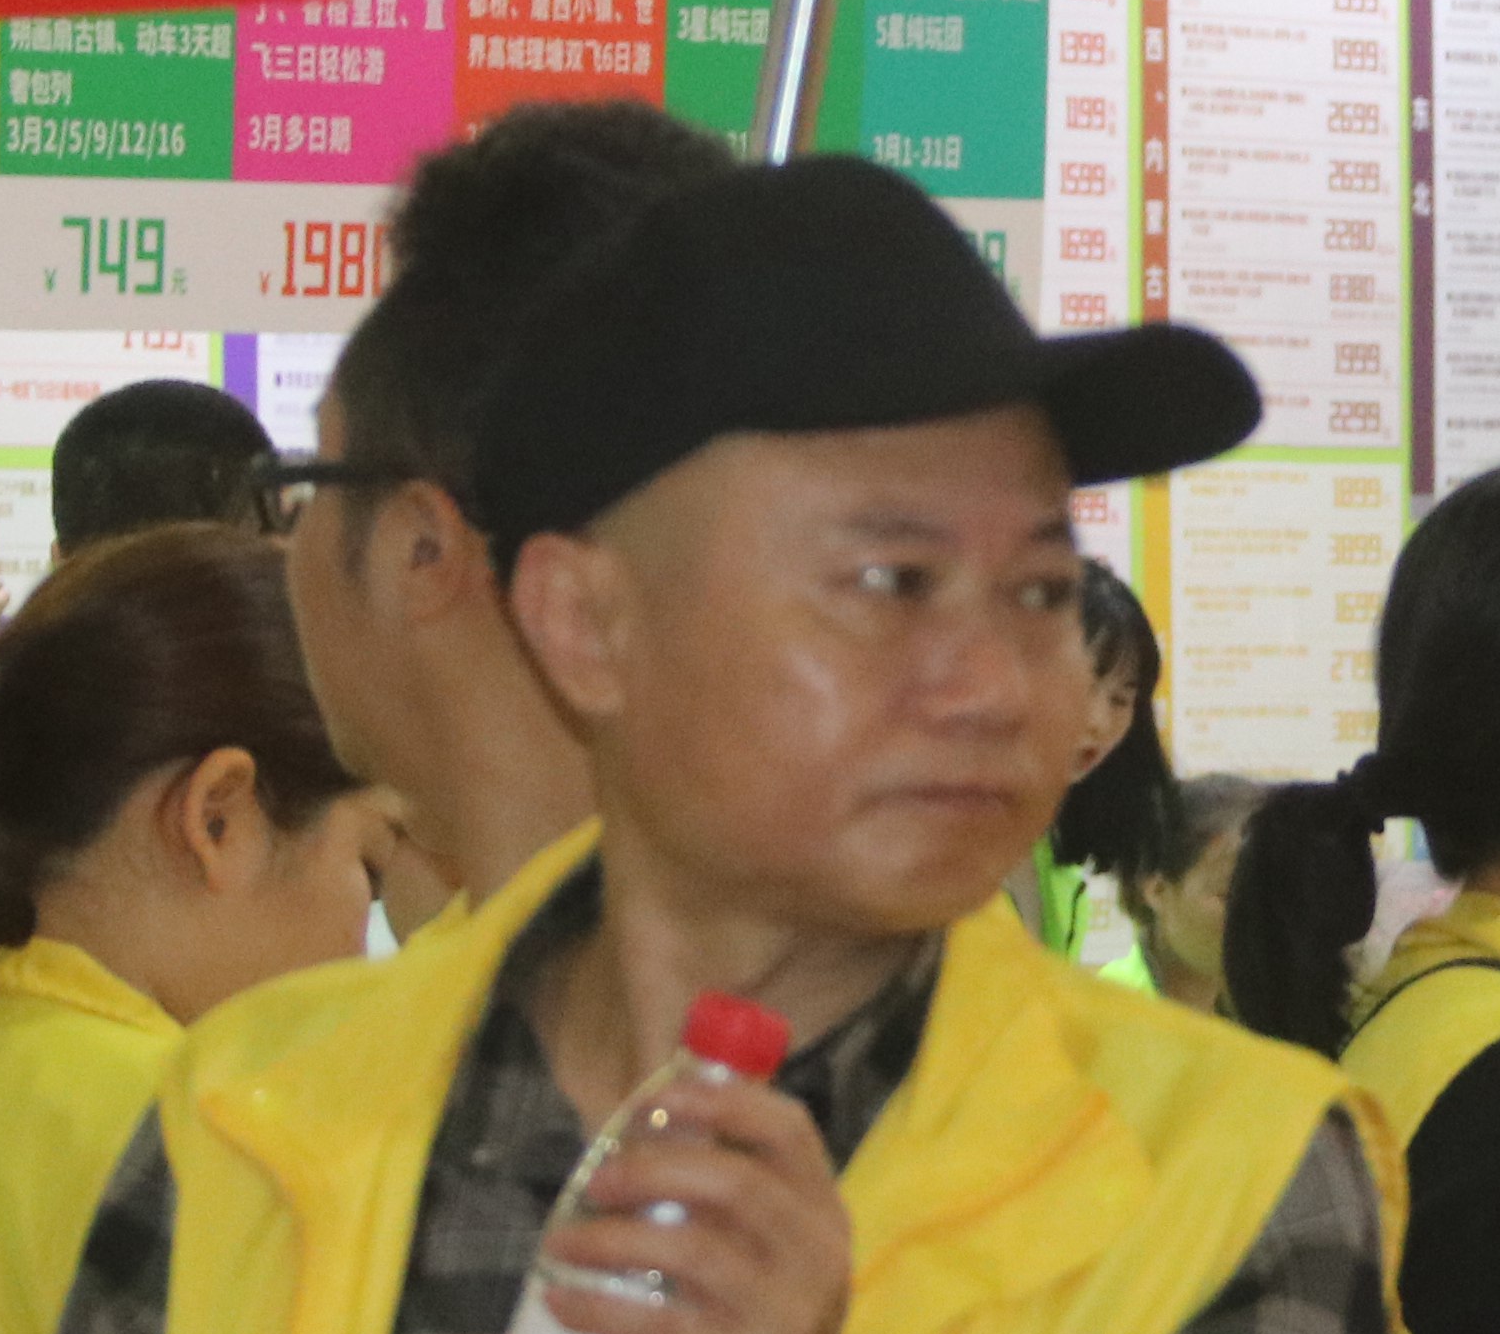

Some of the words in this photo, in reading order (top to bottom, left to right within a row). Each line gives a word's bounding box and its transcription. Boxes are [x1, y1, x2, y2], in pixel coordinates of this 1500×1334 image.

[5, 115, 187, 161] 3月2/5/9/12/16
[248, 114, 352, 154] 3月多日期
